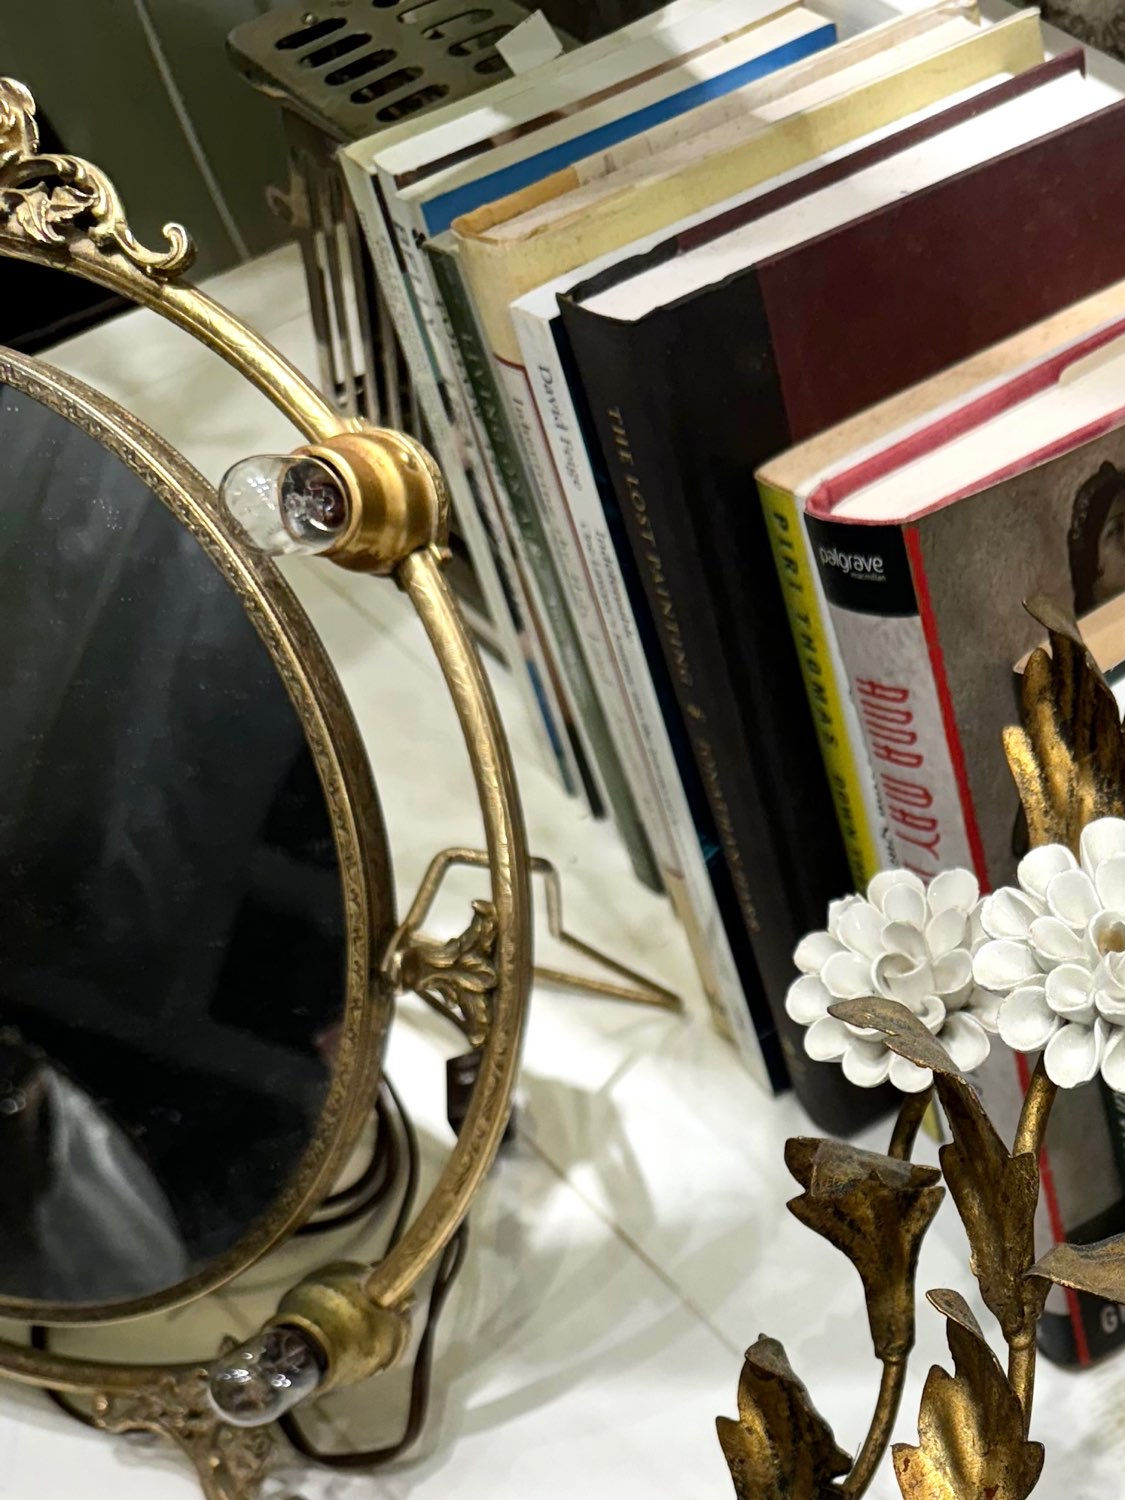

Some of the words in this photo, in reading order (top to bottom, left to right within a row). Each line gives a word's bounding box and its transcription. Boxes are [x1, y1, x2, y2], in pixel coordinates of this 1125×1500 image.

[608, 405, 635, 465] THE
[625, 474, 656, 547] LOST
[646, 552, 693, 688] PAINTING
[773, 511, 804, 593] PIRI
[797, 611, 839, 749] THOMAS
[819, 546, 885, 574] palgrave
